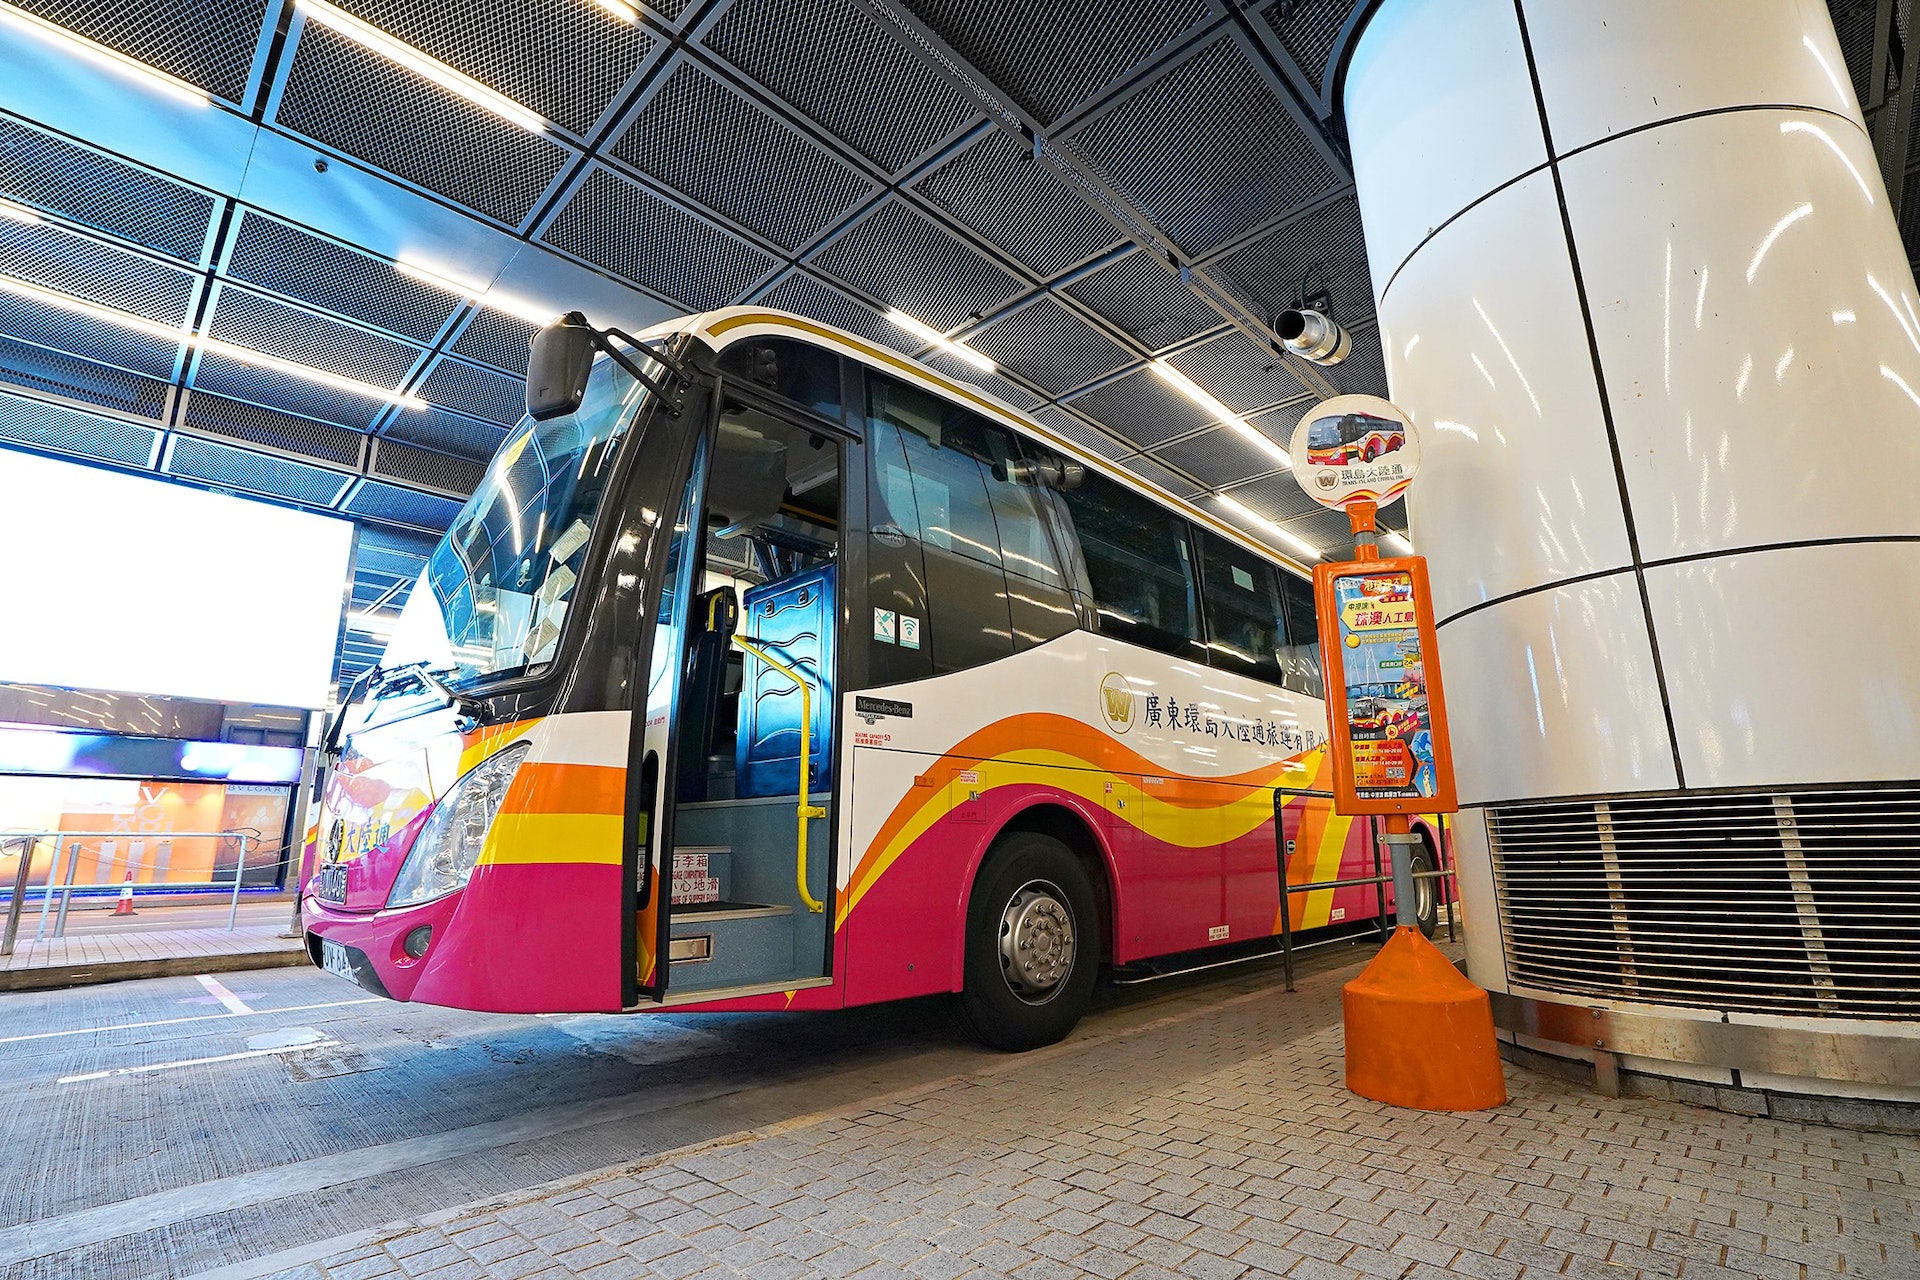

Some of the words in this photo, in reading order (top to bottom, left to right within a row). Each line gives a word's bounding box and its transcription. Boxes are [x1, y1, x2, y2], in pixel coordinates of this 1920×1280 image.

[1341, 463, 1403, 480] 環島大陸通
[858, 699, 911, 715] Mercedes-Benz
[884, 734, 891, 742] 53
[343, 817, 390, 855] 大陸通
[673, 878, 719, 892] 心地滑
